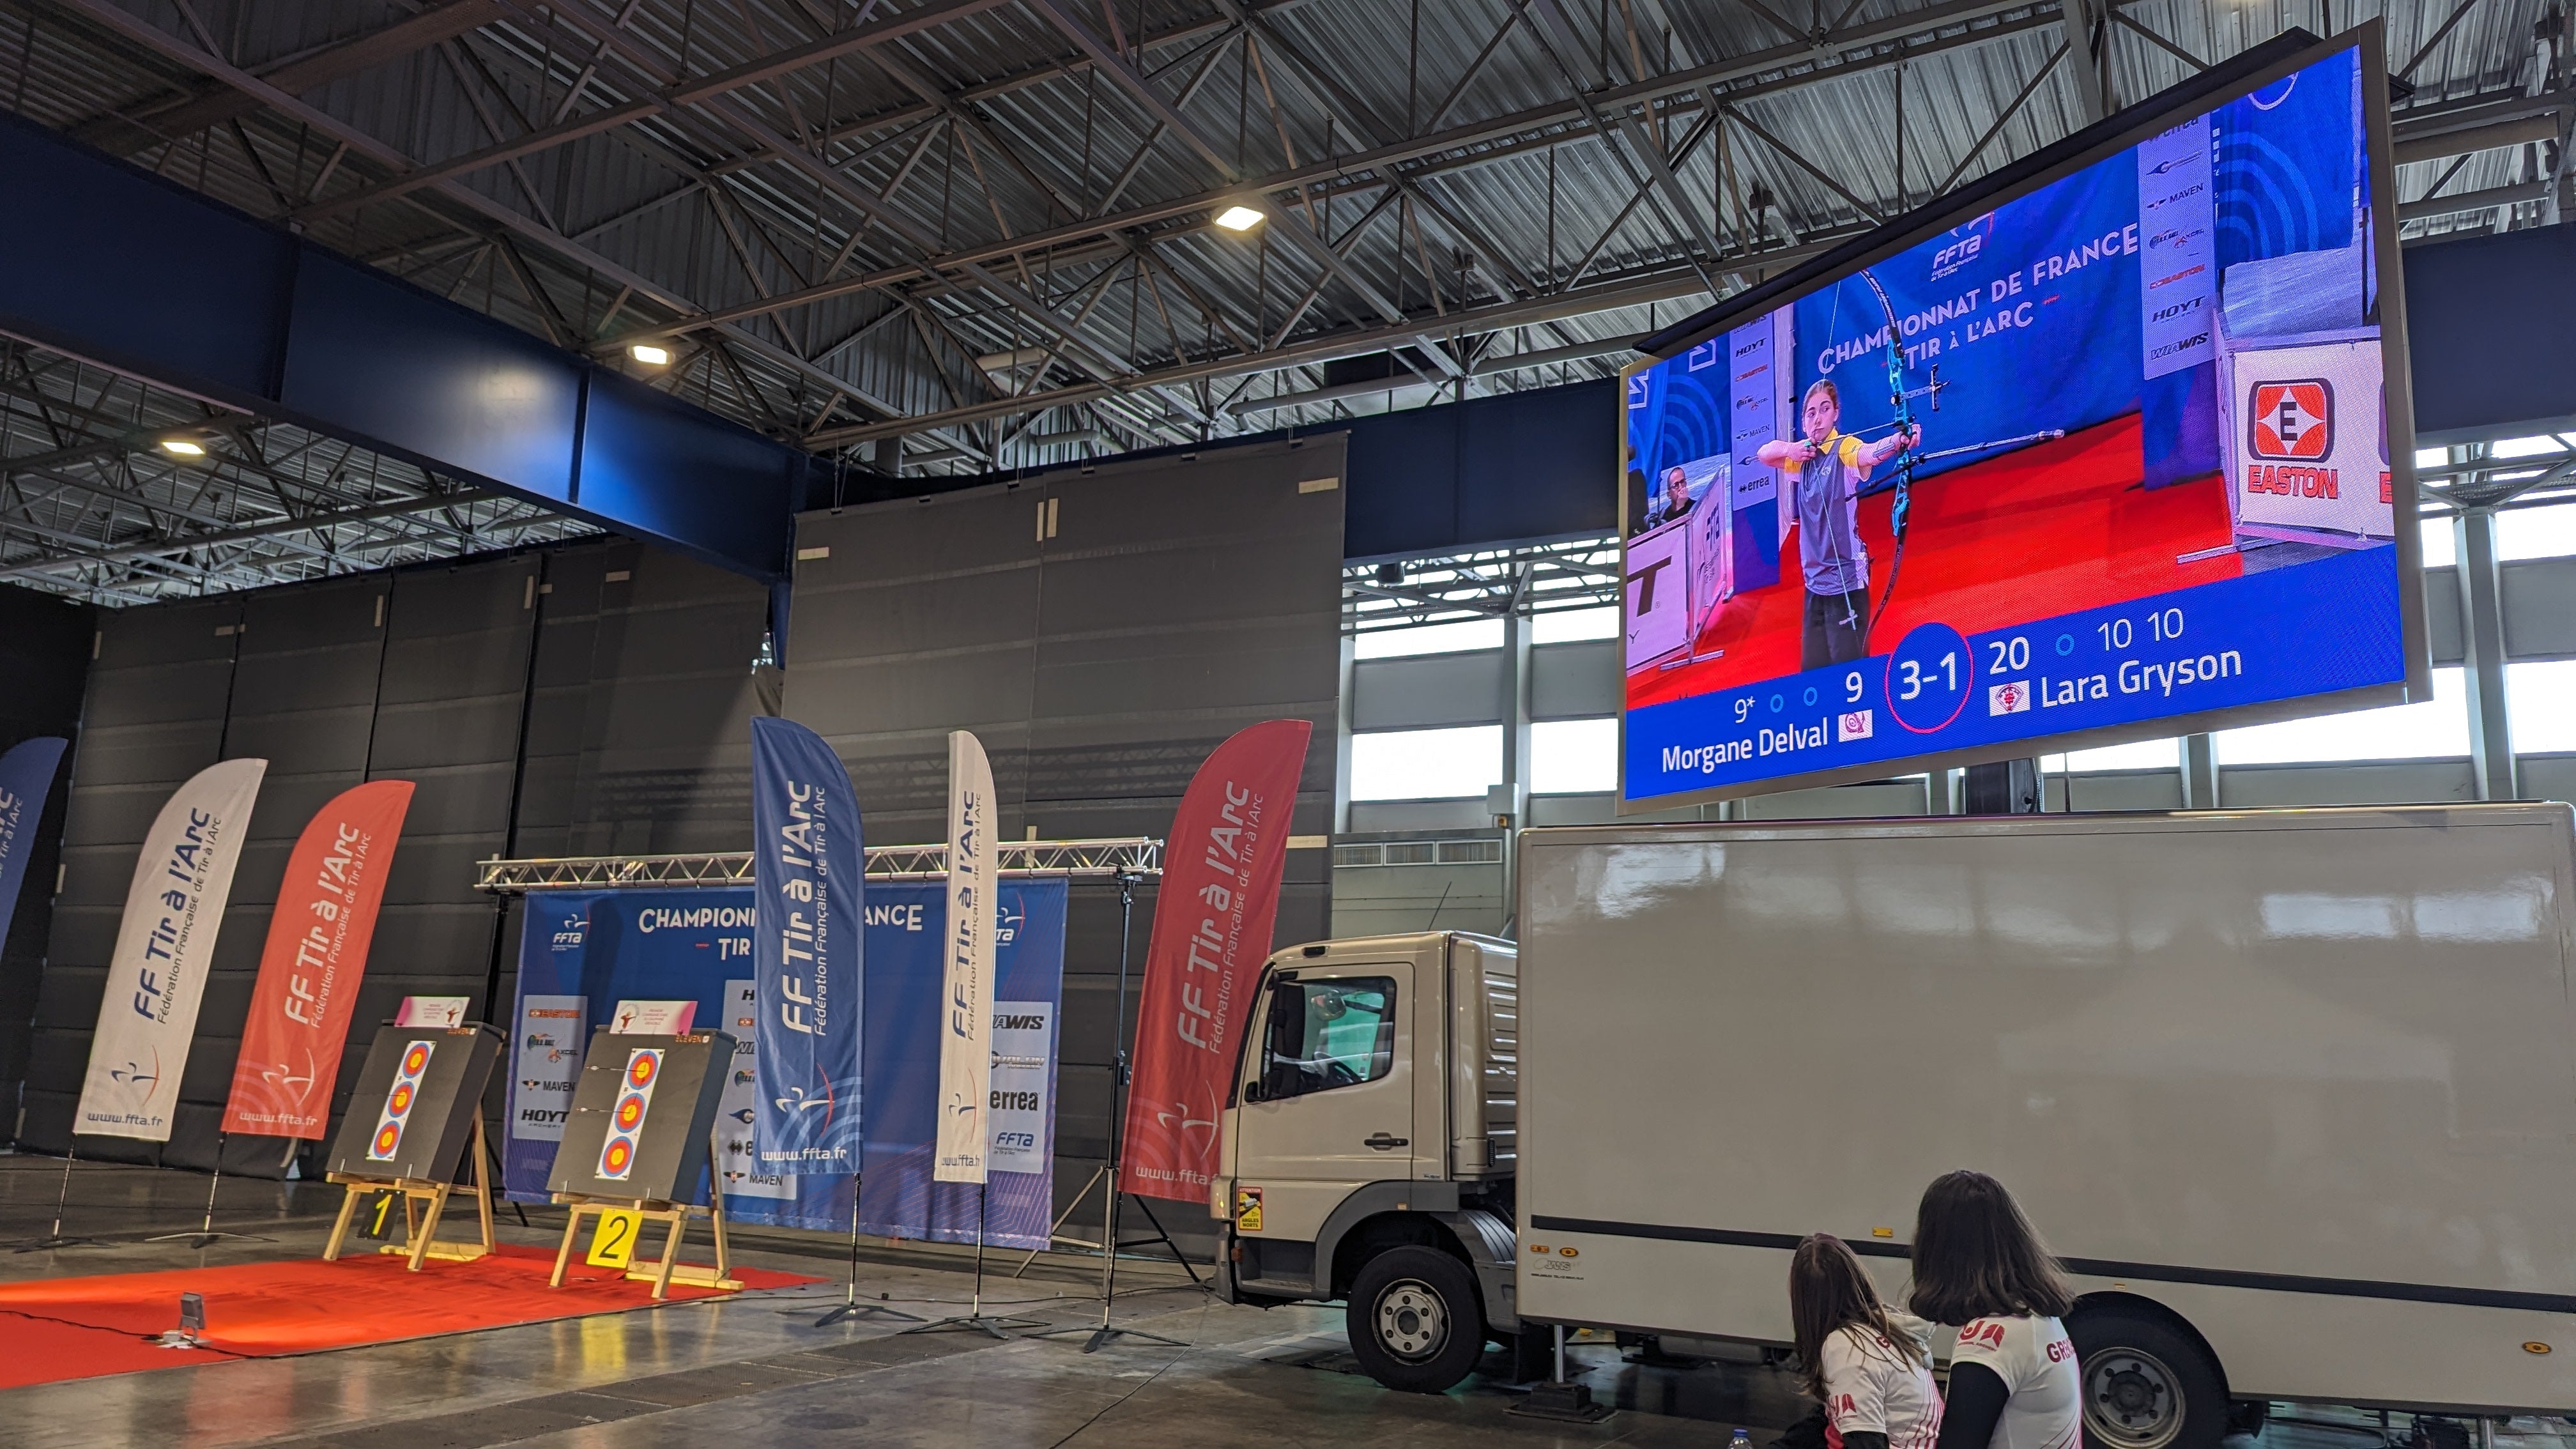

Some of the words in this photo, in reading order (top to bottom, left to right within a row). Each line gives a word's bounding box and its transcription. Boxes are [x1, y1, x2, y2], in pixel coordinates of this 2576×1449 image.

[2169, 183, 2204, 203] MAVEN
[1818, 289, 1981, 374] CHAMPIONNAT
[1991, 271, 2022, 302] DE
[2033, 222, 2139, 286] FRANCE
[2152, 296, 2205, 322] HOYT
[1735, 337, 1767, 358] HOYT
[1905, 337, 1940, 371] TIR
[1949, 330, 1959, 350] À
[1967, 302, 2034, 343] L'ARC
[1749, 424, 1770, 438] MAVEN
[2280, 402, 2298, 441] E
[2248, 465, 2338, 499] EASTON
[1989, 636, 2030, 675] 20
[2097, 618, 2132, 651] 10
[2147, 608, 2184, 641] 10
[1845, 671, 1863, 702] 9
[1900, 652, 1956, 700] 3-1
[2041, 677, 2108, 708] Lara
[2119, 650, 2242, 697] Gryson
[1662, 739, 1752, 774] Morgane
[1759, 717, 1828, 756] Delval
[168, 807, 210, 882] l'Arc
[781, 780, 812, 868] l'Arc
[813, 822, 826, 832] à
[814, 835, 827, 854] Tir
[960, 790, 974, 873] l'Arc
[1205, 780, 1249, 875] l'Arc
[1245, 831, 1257, 842] à
[197, 857, 210, 873] Tir
[318, 822, 359, 894] l'Arc
[815, 858, 827, 876] de
[973, 864, 979, 880] de
[1240, 844, 1254, 863] Tir
[193, 877, 204, 892] de
[344, 889, 356, 903] de
[347, 870, 360, 886] Tir
[783, 878, 812, 903] à
[958, 886, 972, 908] à
[1199, 884, 1230, 911] à
[1237, 868, 1250, 887] de
[160, 889, 187, 911] à
[310, 900, 339, 921] à
[639, 907, 756, 933] CHAMPION
[865, 905, 923, 931] ANCE
[815, 880, 829, 953] Française
[145, 917, 177, 960] Tir
[175, 896, 199, 956] Française
[327, 906, 351, 963] Française
[783, 912, 813, 965] Tir
[970, 887, 979, 957] Française
[1223, 891, 1245, 967] Française
[296, 926, 330, 968] Tir
[718, 937, 751, 960] TIR
[956, 919, 970, 971] Tir
[1187, 918, 1223, 972] Tir
[134, 968, 160, 1020] FF
[157, 958, 182, 1024] Fédération
[284, 974, 314, 1025] FF
[310, 964, 335, 1028] Fédération
[782, 974, 812, 1034] FF
[814, 956, 827, 1036] Fédération
[953, 982, 967, 1038] FF
[967, 962, 976, 1041] Fédération
[1209, 970, 1232, 1054] Fédération
[993, 1015, 1045, 1030] AWIS
[1177, 982, 1211, 1049] FF
[543, 1080, 576, 1092] MAVEN
[87, 1112, 164, 1127] www.ffta.fr
[239, 1111, 318, 1126] www.ffta.fr
[521, 1108, 570, 1123] HOYT
[761, 1147, 847, 1162] www.ffta.fr
[749, 1174, 783, 1186] MAVEN
[375, 1193, 392, 1236] 1
[599, 1215, 629, 1259] 2
